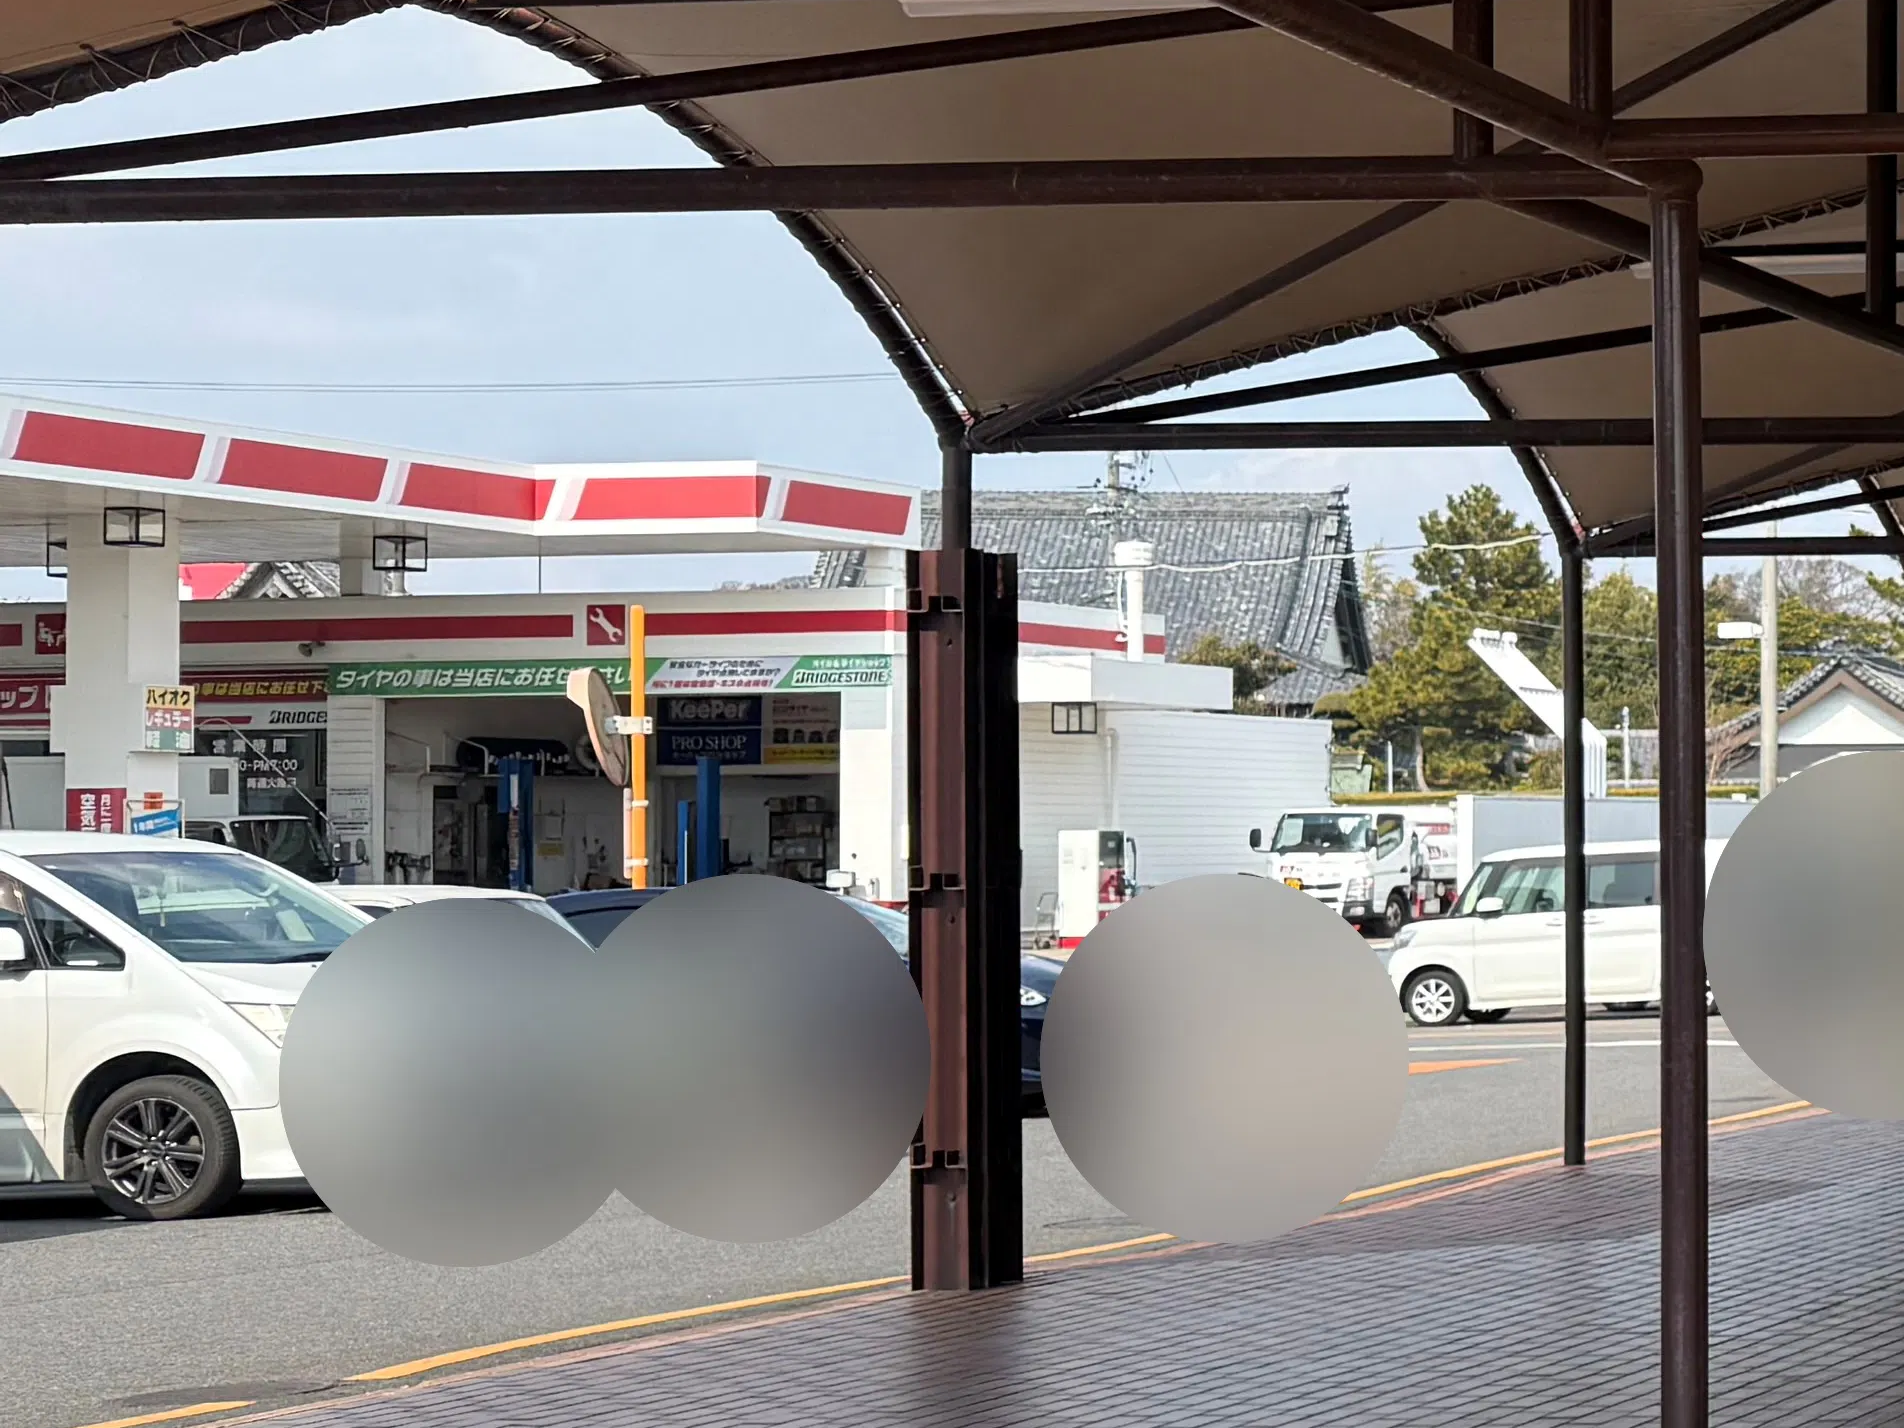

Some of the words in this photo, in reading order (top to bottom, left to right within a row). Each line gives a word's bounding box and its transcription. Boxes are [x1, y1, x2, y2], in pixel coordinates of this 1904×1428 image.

[794, 671, 885, 684] BRIDGESTONE
[146, 688, 191, 706] ハイオク
[671, 698, 749, 720] KeePer
[146, 710, 191, 727] レギュラー
[671, 735, 703, 750] PRO
[705, 733, 748, 750] SHOP
